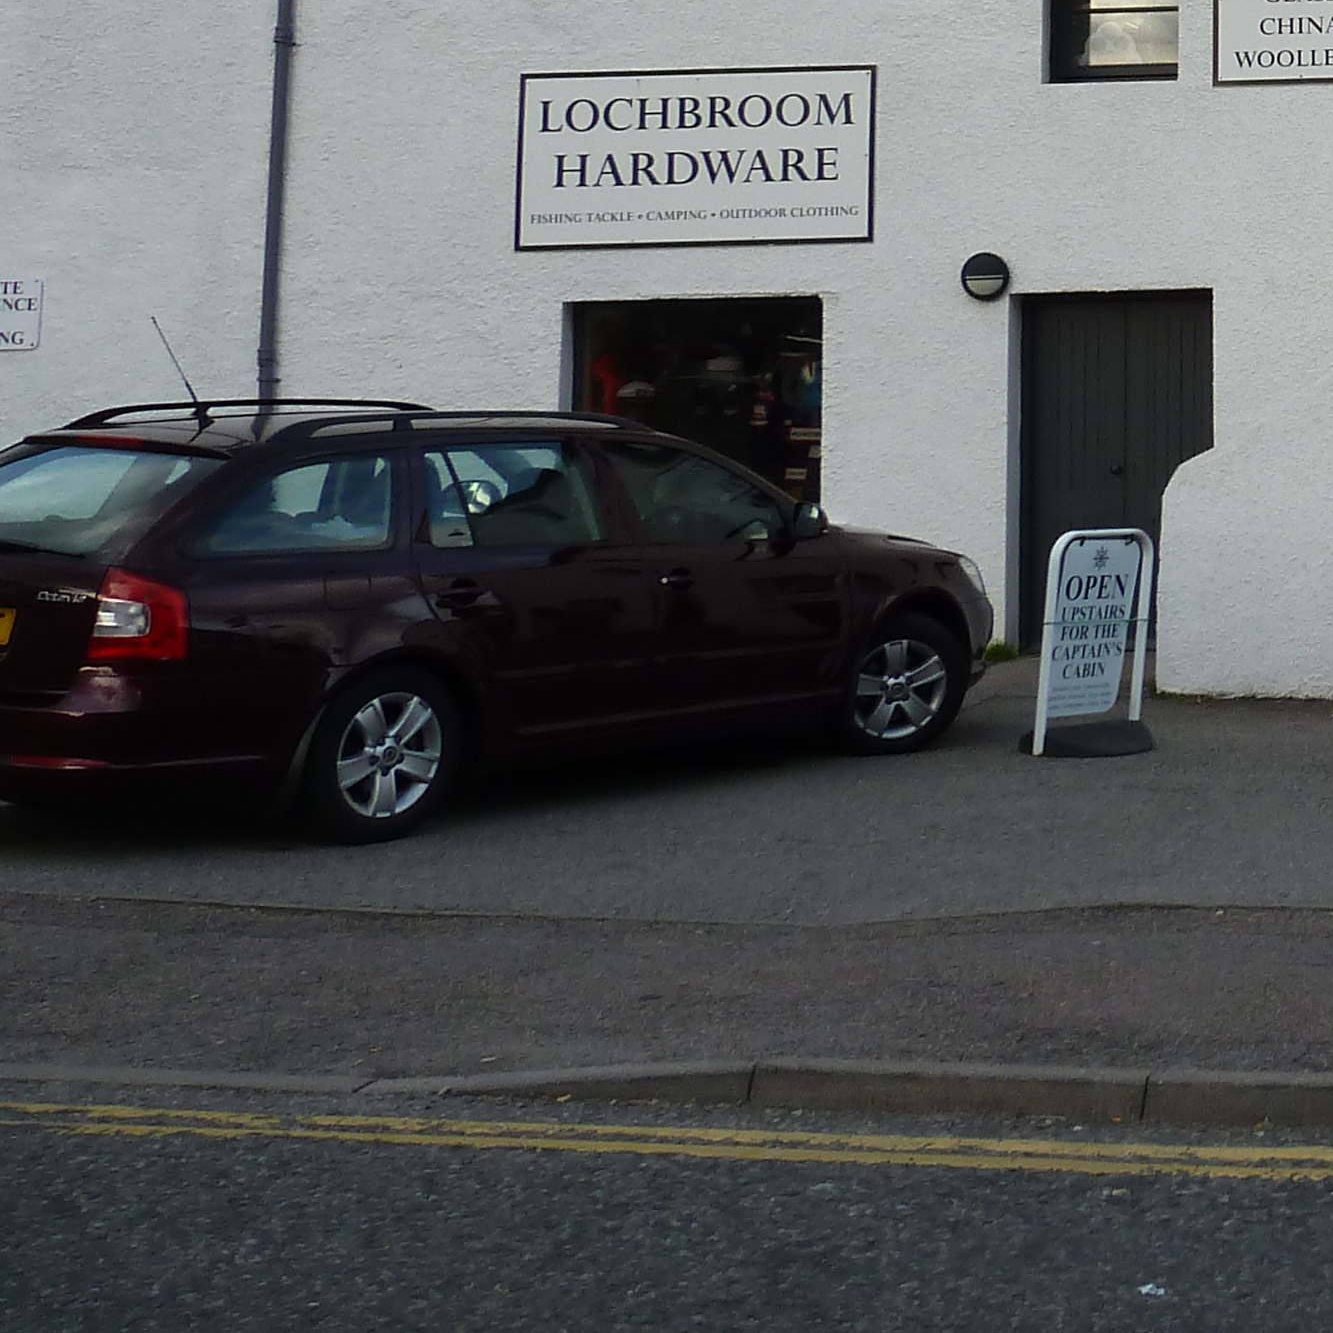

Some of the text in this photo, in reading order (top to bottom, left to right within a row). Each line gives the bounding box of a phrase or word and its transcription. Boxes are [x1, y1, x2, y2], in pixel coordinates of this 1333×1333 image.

[538, 92, 856, 133] LOCHBROOM
[552, 147, 840, 188] HARDWARE
[530, 205, 860, 224] FISHING TACKLE CAMPING OUTDOOR CLOTHING
[1065, 574, 1129, 601] OPEN
[1062, 605, 1126, 622] UPSTAIRS
[1060, 622, 1119, 642] FOR THE
[1052, 642, 1123, 661] CAPTAIN'S
[1062, 662, 1106, 680] CABIN
